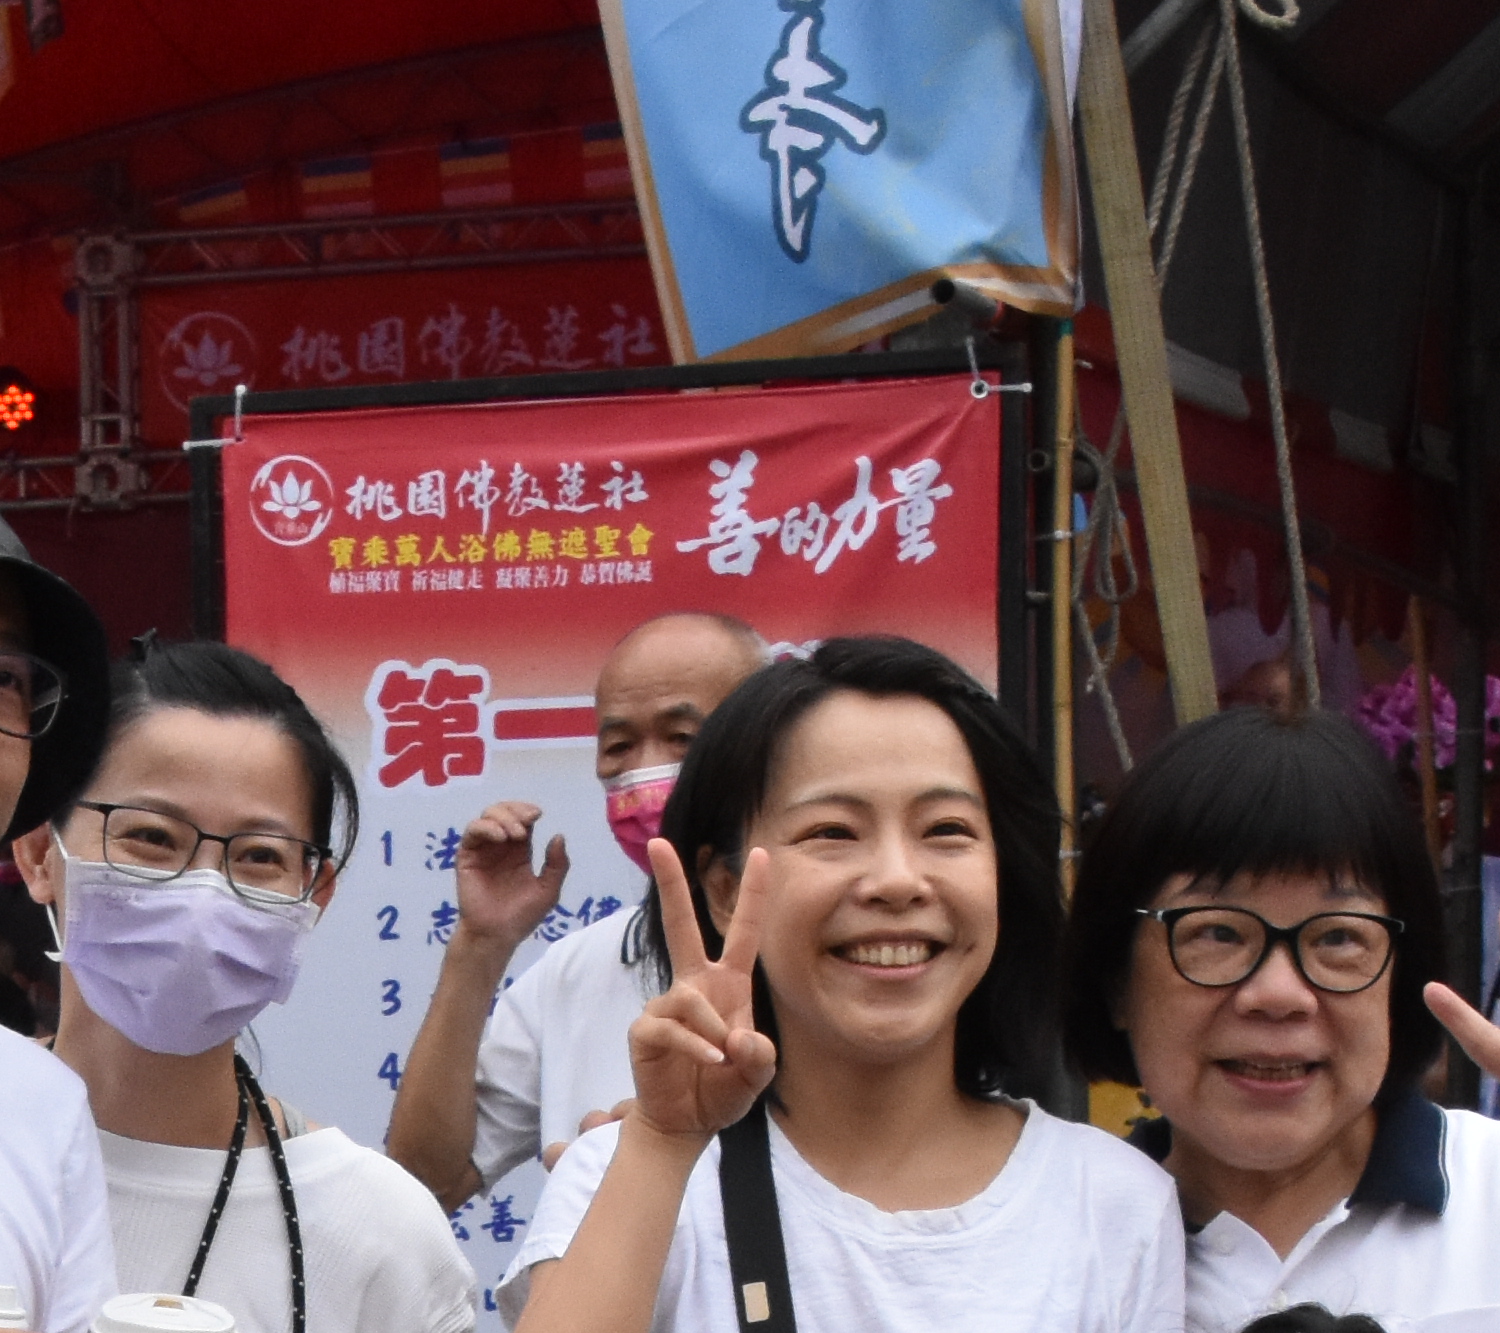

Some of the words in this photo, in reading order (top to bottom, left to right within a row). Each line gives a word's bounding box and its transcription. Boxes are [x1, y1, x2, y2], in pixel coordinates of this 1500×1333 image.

[345, 459, 650, 536] 桃園佛教蓮社
[675, 449, 953, 576] 善的力量
[328, 522, 655, 570] 寶乘萬人浴佛無遮聖會
[411, 563, 483, 591] 祈福健走
[380, 830, 393, 867] 1
[377, 906, 400, 942] 2
[381, 979, 401, 1016] 3
[377, 1052, 402, 1091] 4
